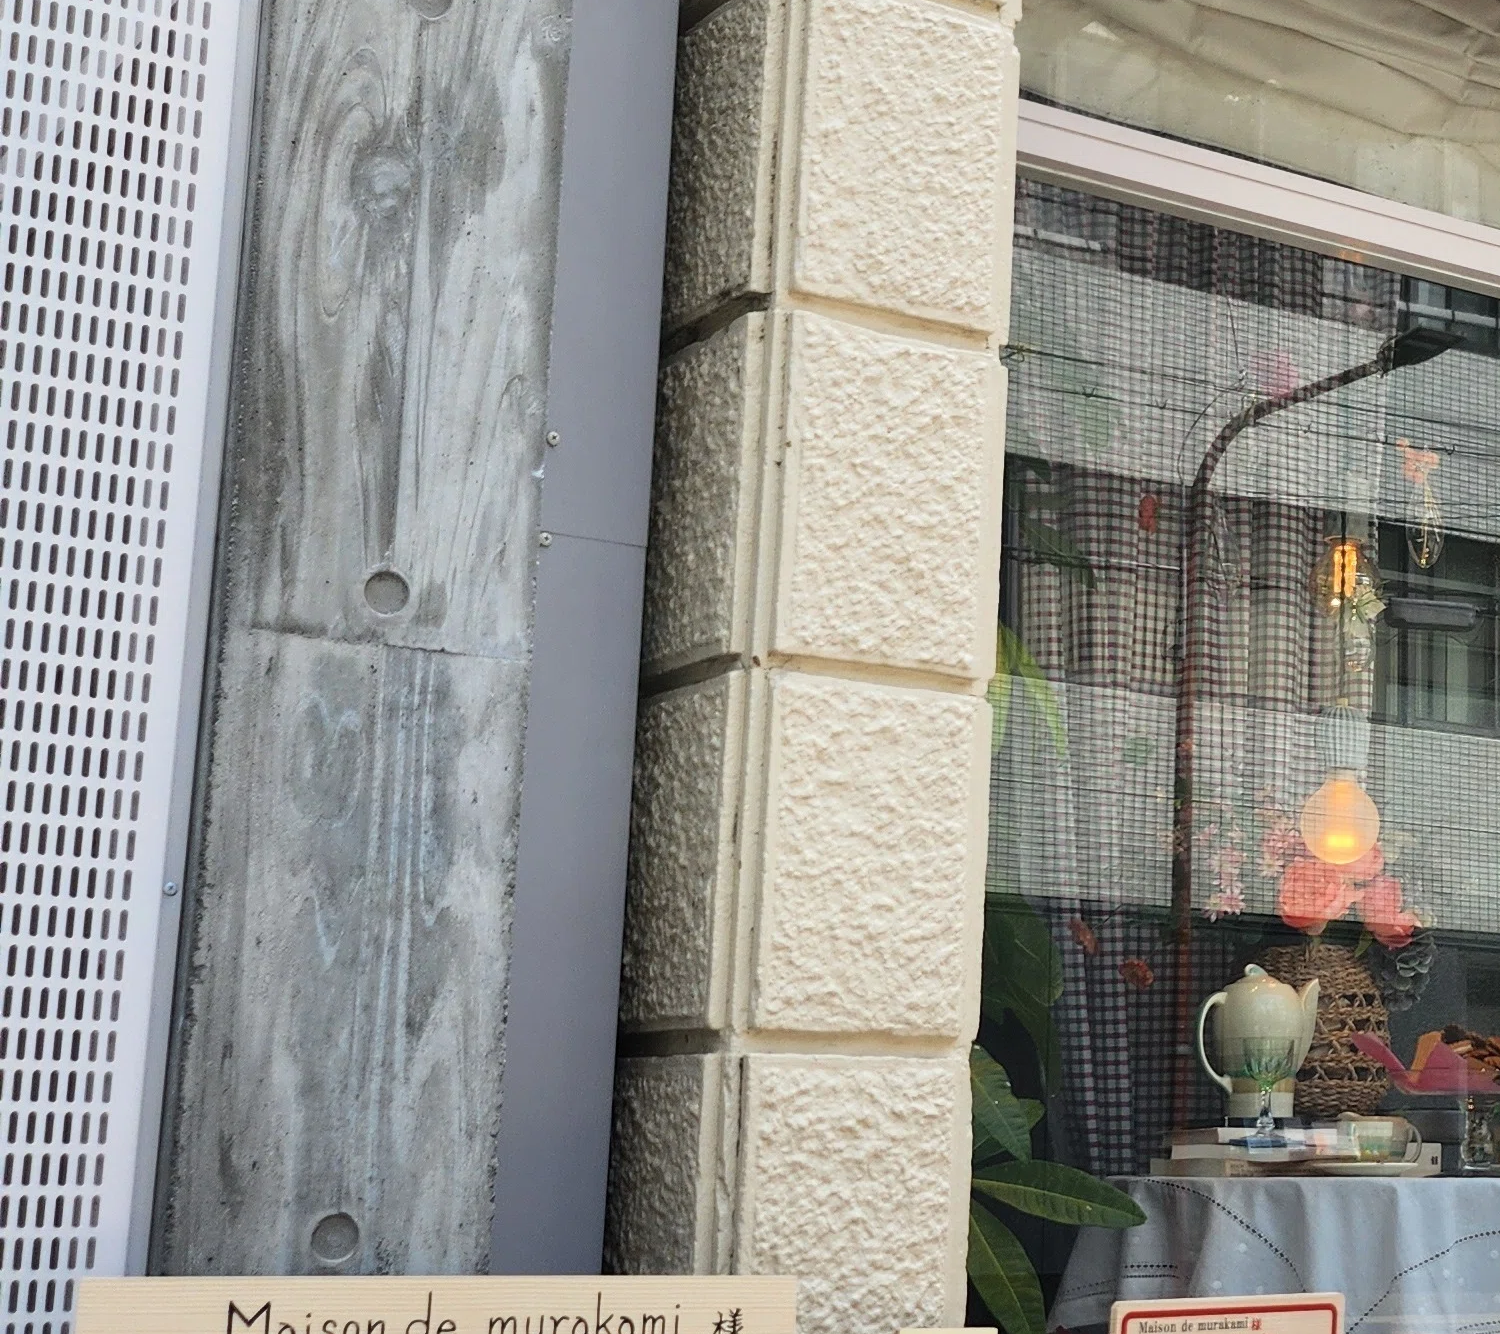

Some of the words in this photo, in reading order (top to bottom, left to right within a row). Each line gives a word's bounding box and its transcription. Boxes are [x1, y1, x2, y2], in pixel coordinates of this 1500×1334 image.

[1139, 1321, 1177, 1334] Maison
[1181, 1319, 1194, 1332] de
[1198, 1317, 1249, 1331] murakami
